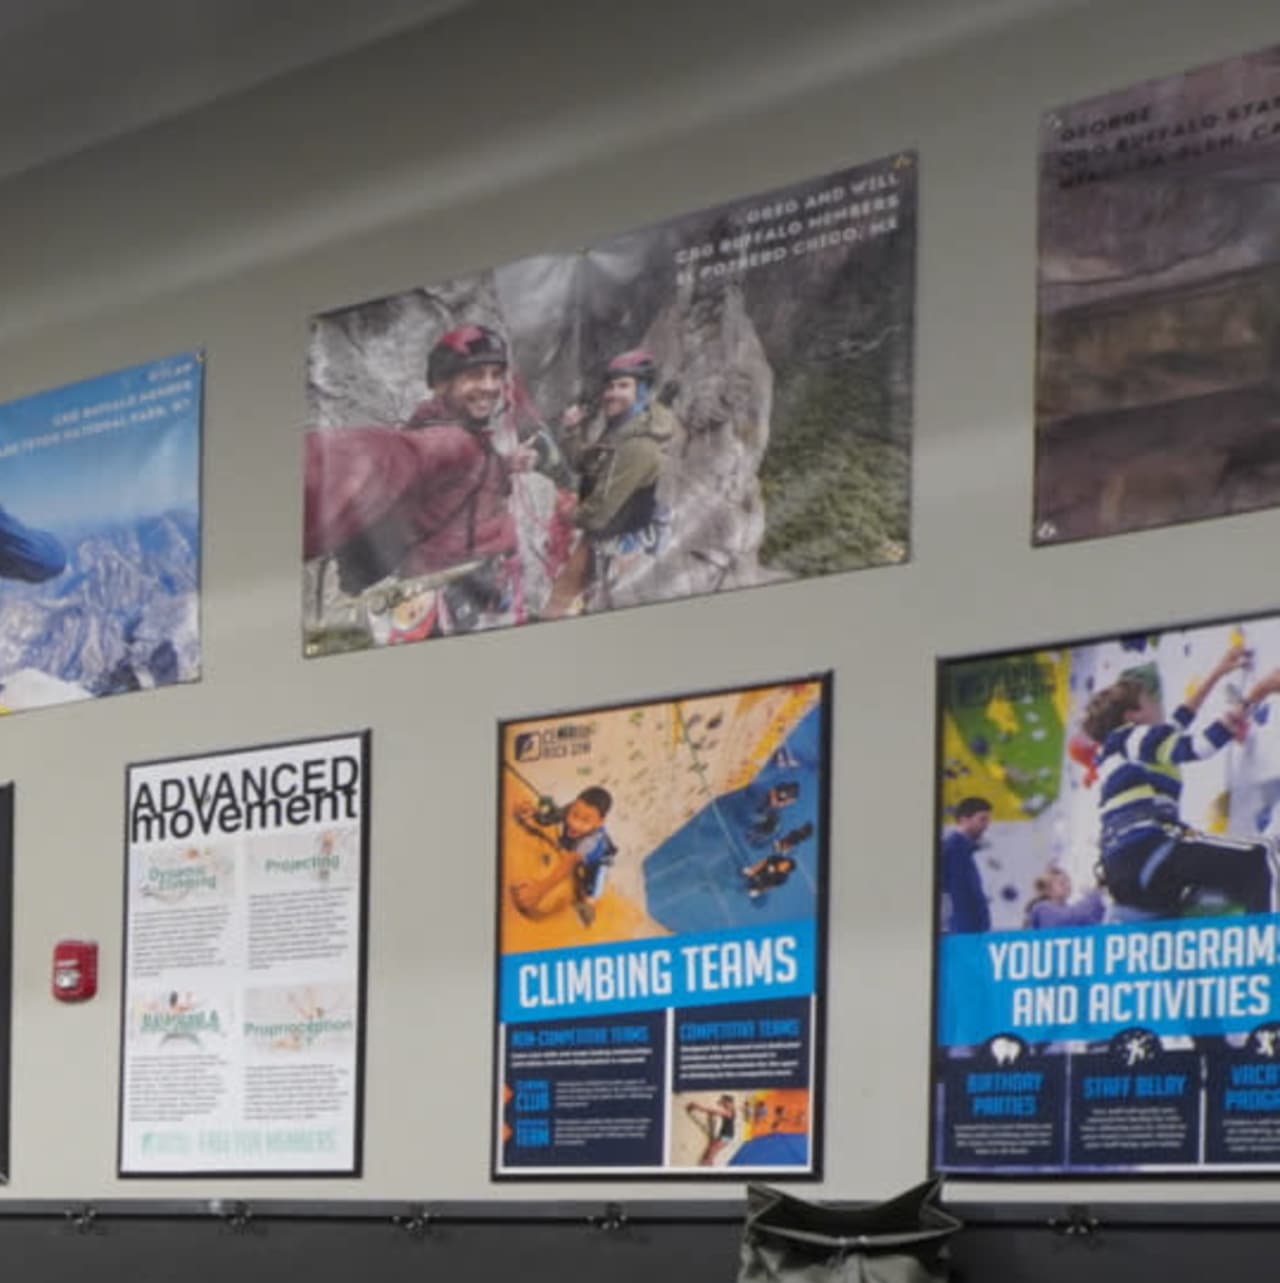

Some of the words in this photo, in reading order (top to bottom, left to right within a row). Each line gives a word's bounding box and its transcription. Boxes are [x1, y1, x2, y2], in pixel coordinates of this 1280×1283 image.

[804, 187, 845, 209] AND
[851, 172, 900, 196] WILL
[718, 221, 803, 252] BUFFALO
[807, 193, 901, 230] MEMBERS
[132, 755, 360, 822] ADVANCED
[264, 853, 340, 875] Projecting
[519, 950, 673, 1008] CLIMBING
[682, 936, 797, 992] TEAMS
[990, 937, 1092, 981] YOUTH
[1105, 925, 1280, 976] PROGRAM
[1013, 985, 1077, 1026] AND
[1090, 975, 1270, 1023] ACTIVITIES
[967, 1072, 1044, 1093] BIRTHDAY
[1083, 1077, 1130, 1098] STAFF
[1135, 1075, 1186, 1096] BELAY
